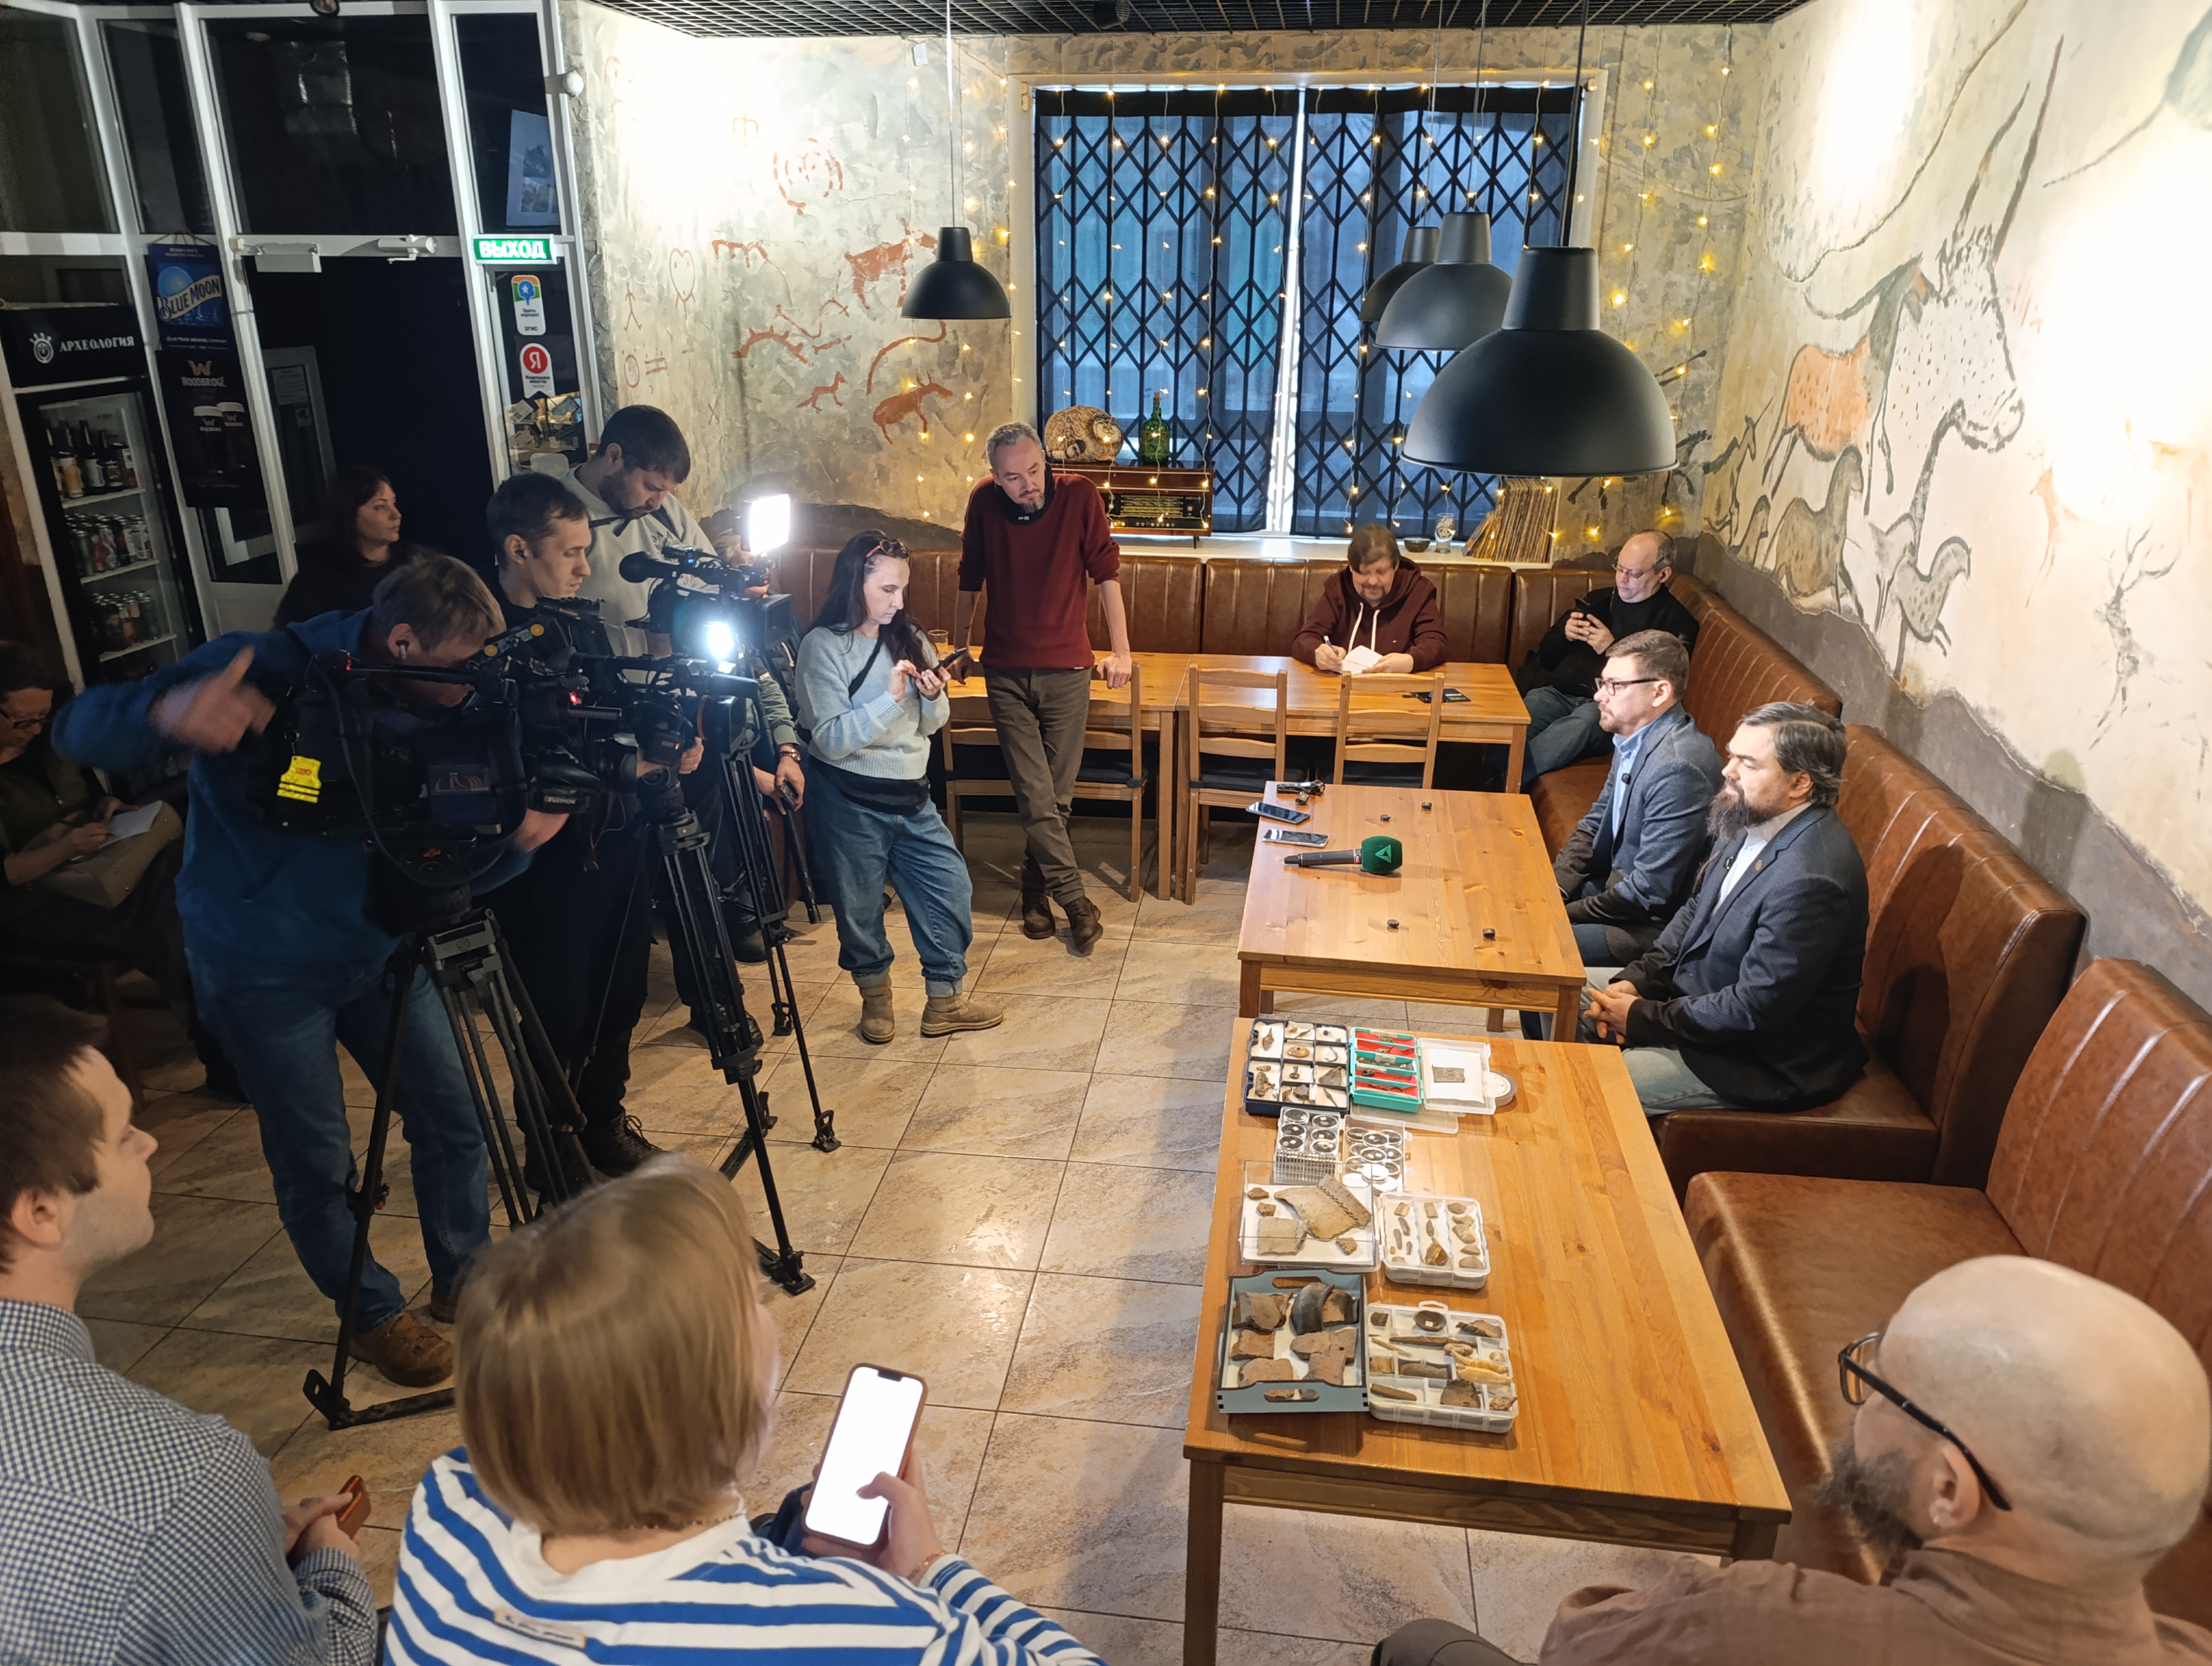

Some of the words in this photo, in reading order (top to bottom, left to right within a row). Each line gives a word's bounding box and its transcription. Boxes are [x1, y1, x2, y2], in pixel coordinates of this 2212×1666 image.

[479, 240, 546, 259] ВЫХОД
[159, 292, 189, 322] BLUE
[189, 278, 220, 304] MOON
[59, 336, 135, 352] АРХЕОЛОГИЯ
[529, 351, 542, 369] Я
[181, 376, 226, 387] WOODBRIDGE
[549, 797, 576, 805] FUJINON
